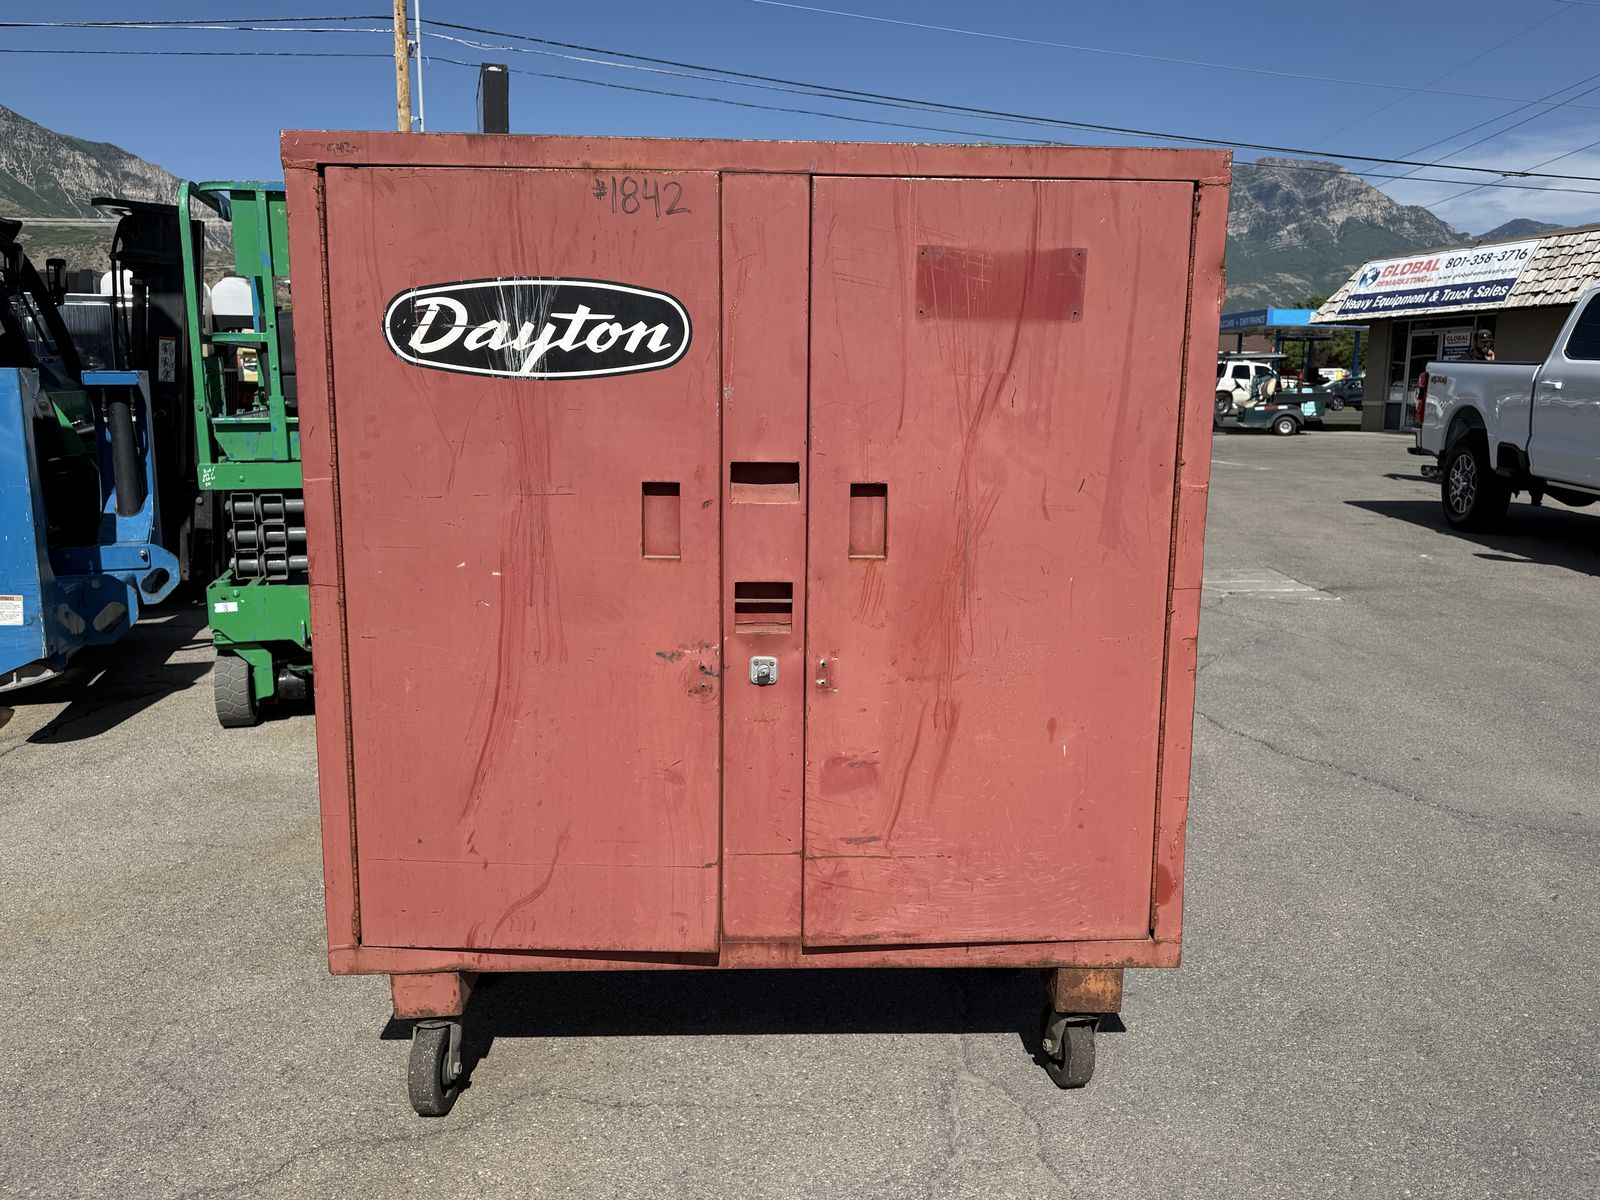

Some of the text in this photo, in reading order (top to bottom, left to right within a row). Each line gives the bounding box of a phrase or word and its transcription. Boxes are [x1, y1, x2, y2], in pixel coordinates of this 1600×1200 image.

[592, 176, 691, 218] #1842
[1381, 248, 1528, 278] GLOBAL 801-358-3716
[1342, 284, 1509, 310] Heavy Equipment & Truck Sales
[408, 296, 672, 374] Dayton
